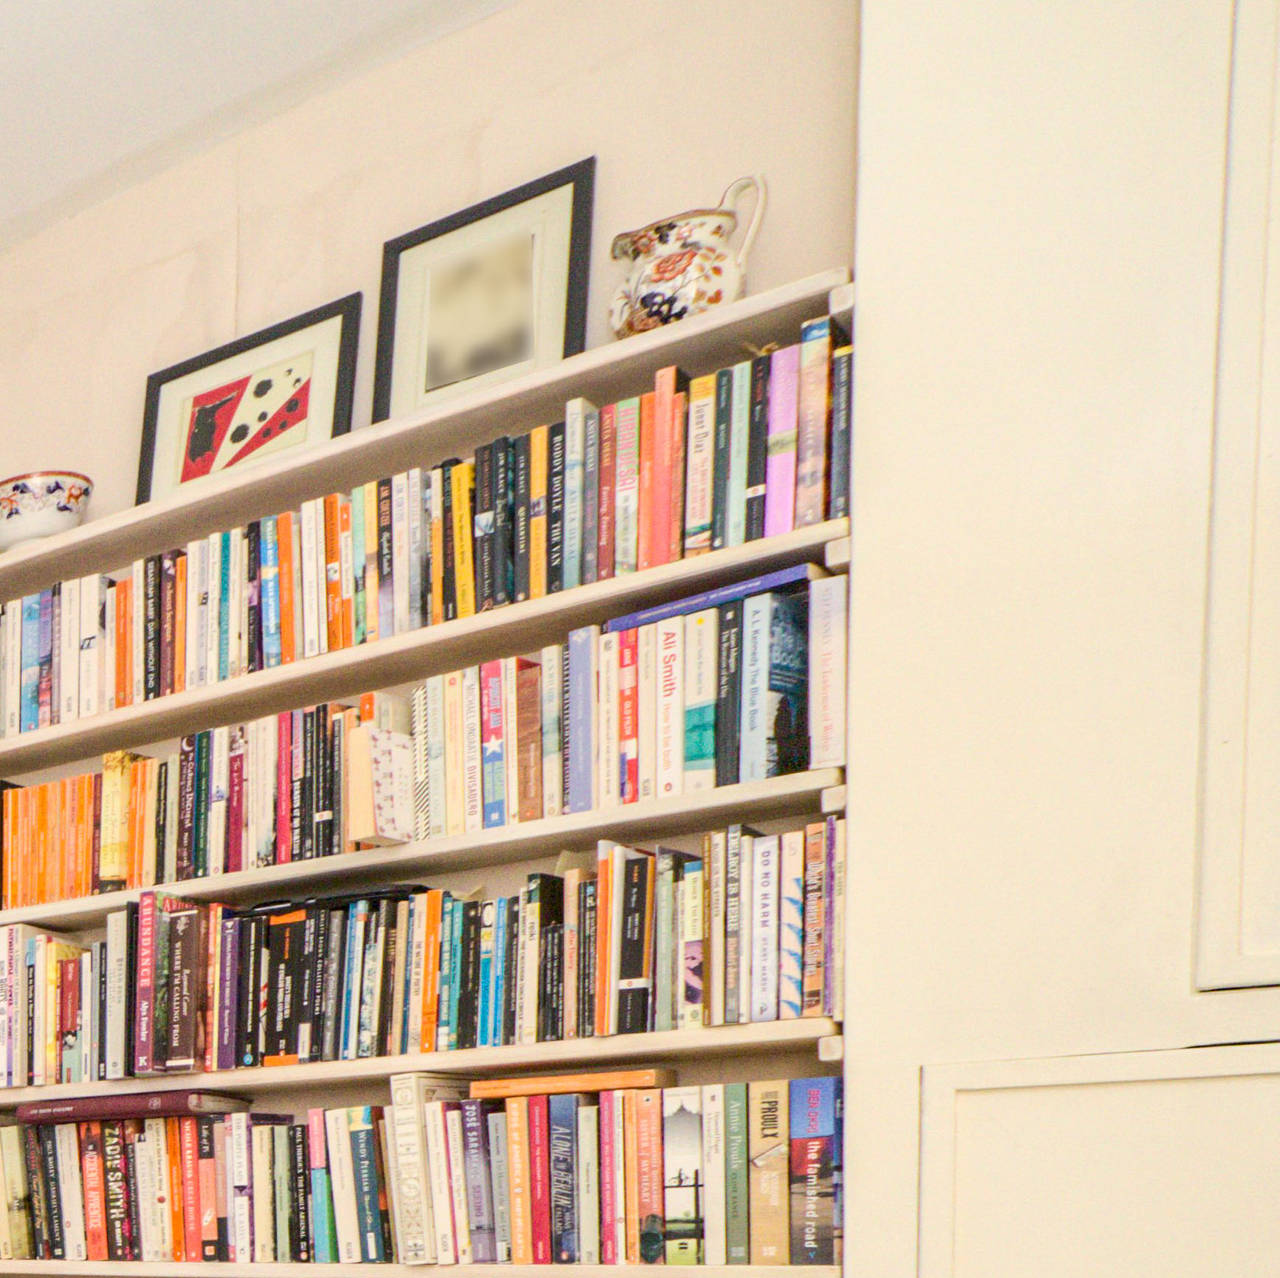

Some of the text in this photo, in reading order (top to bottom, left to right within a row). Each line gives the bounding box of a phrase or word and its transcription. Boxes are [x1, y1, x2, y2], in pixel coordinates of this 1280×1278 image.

[551, 435, 564, 567] RODDY DOYLE THE VAN
[662, 631, 677, 654] Ali
[662, 654, 677, 698] Smith
[749, 687, 759, 708] Blue
[748, 710, 759, 732] Book
[663, 750, 674, 771] both
[467, 765, 477, 816] DIVISADERO
[727, 831, 739, 881] DELROY
[761, 850, 771, 867] DO
[761, 871, 771, 888] NO
[728, 897, 739, 932] HERE
[761, 892, 771, 929] HARM
[140, 896, 153, 988] ABUNDANCE
[528, 921, 536, 942] reiki
[172, 940, 181, 972] WHERE
[172, 986, 181, 1022] CALLING
[171, 1024, 181, 1047] FROM
[728, 1100, 742, 1133] Annie
[761, 1100, 779, 1139] PROULX
[103, 1127, 120, 1169] ZADIE
[296, 1143, 304, 1173] THEROUX
[551, 1125, 572, 1162] ALONE
[729, 1135, 743, 1169] Proulx
[803, 1088, 820, 1248] BEN OKRI the famished road
[108, 1171, 125, 1220] SMITH
[551, 1170, 573, 1209] BERLIN
